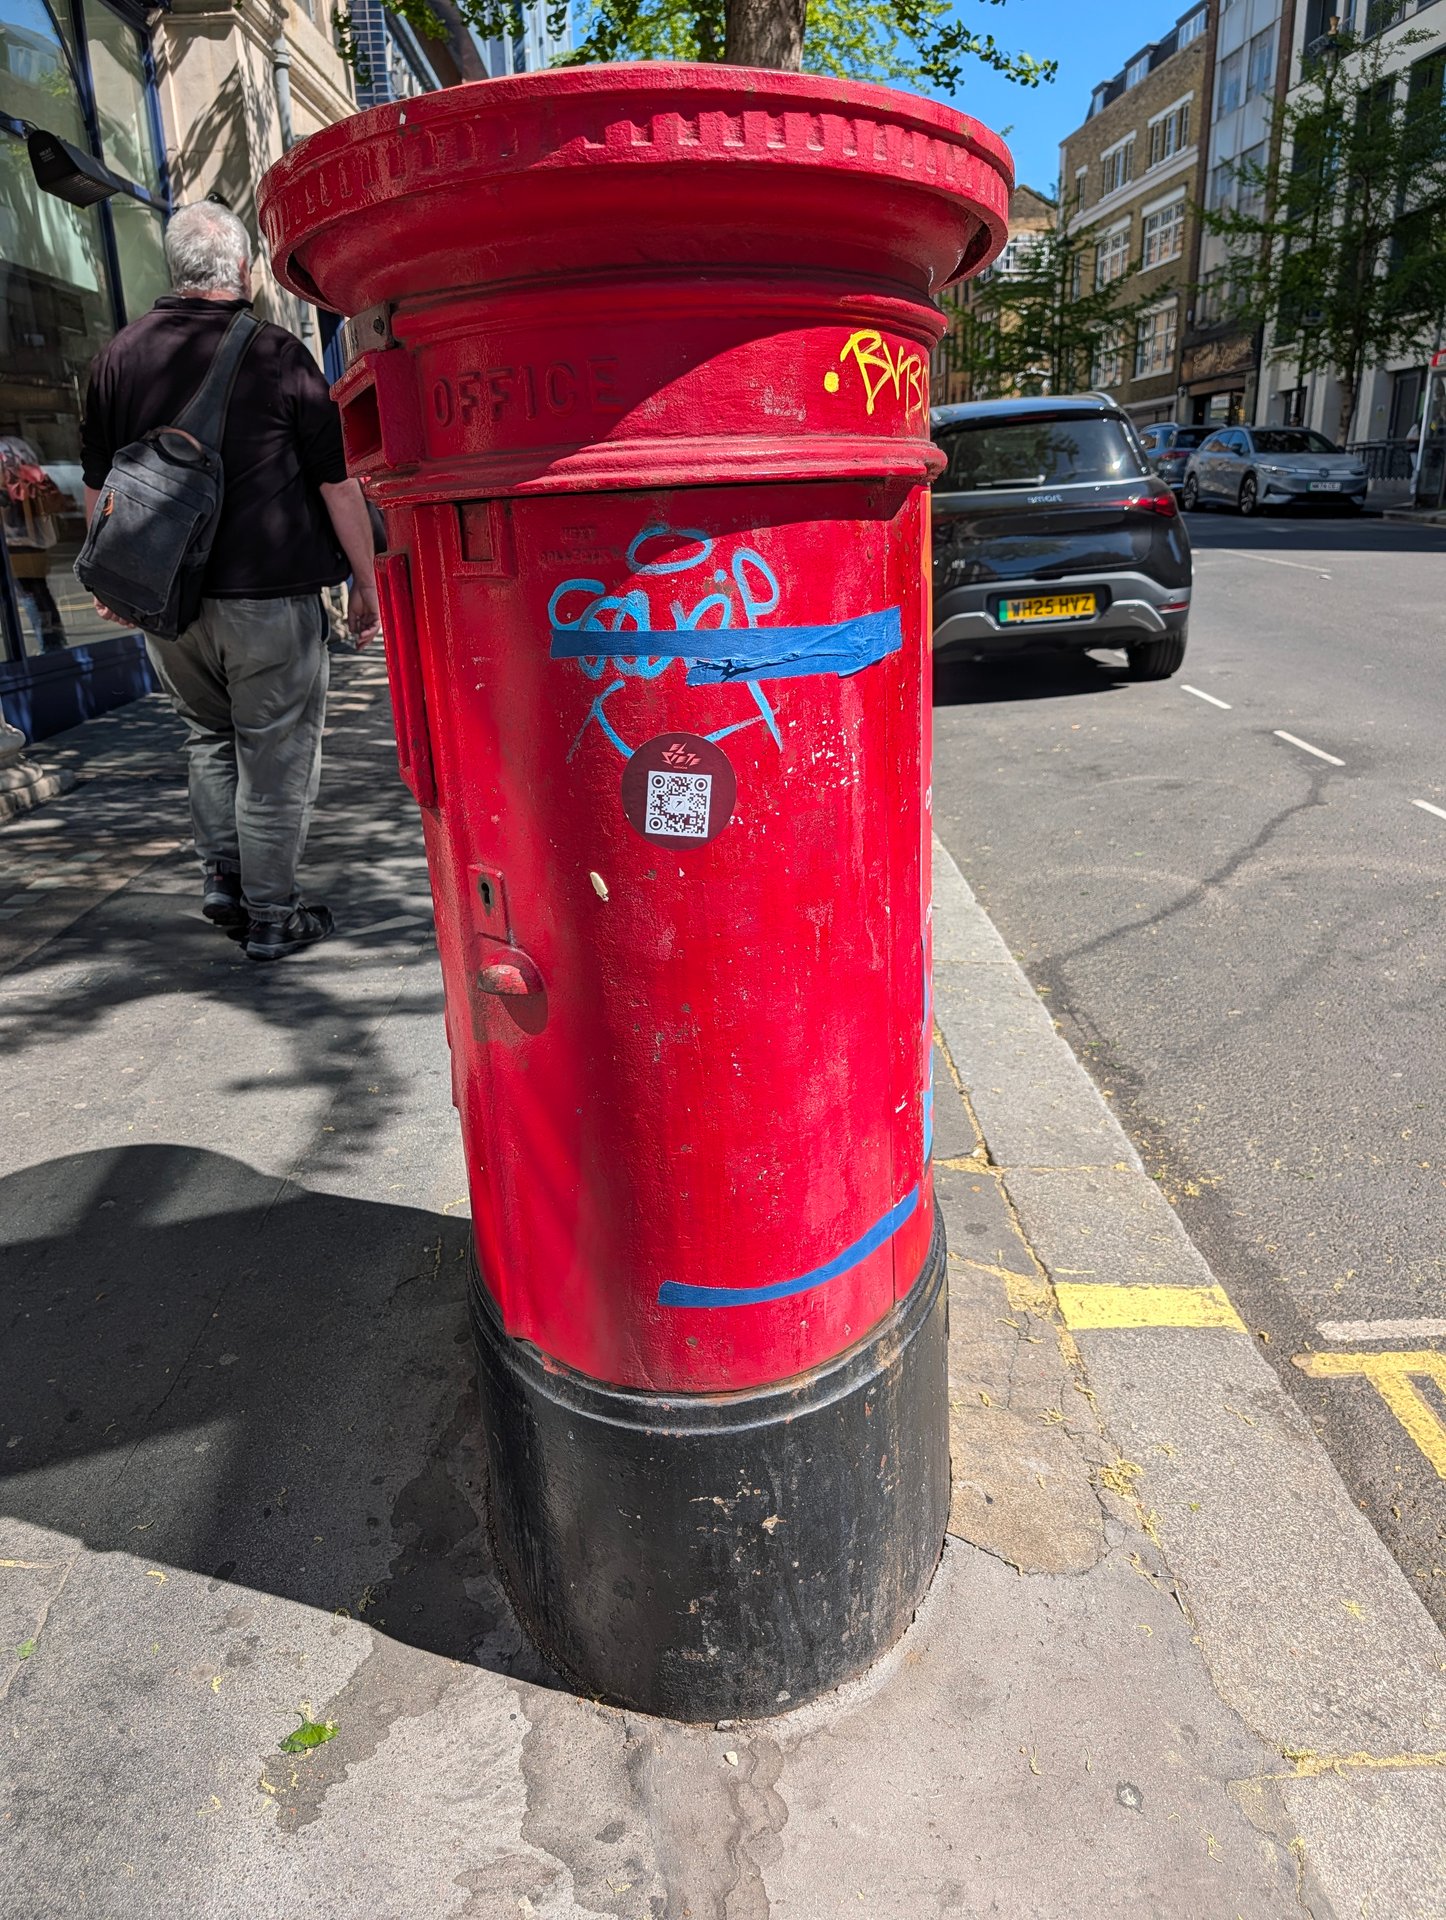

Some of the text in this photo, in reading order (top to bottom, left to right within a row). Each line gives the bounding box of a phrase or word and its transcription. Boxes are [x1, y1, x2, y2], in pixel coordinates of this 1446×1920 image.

[433, 357, 625, 427] OFFICE
[1010, 596, 1091, 617] WH25 HVZ
